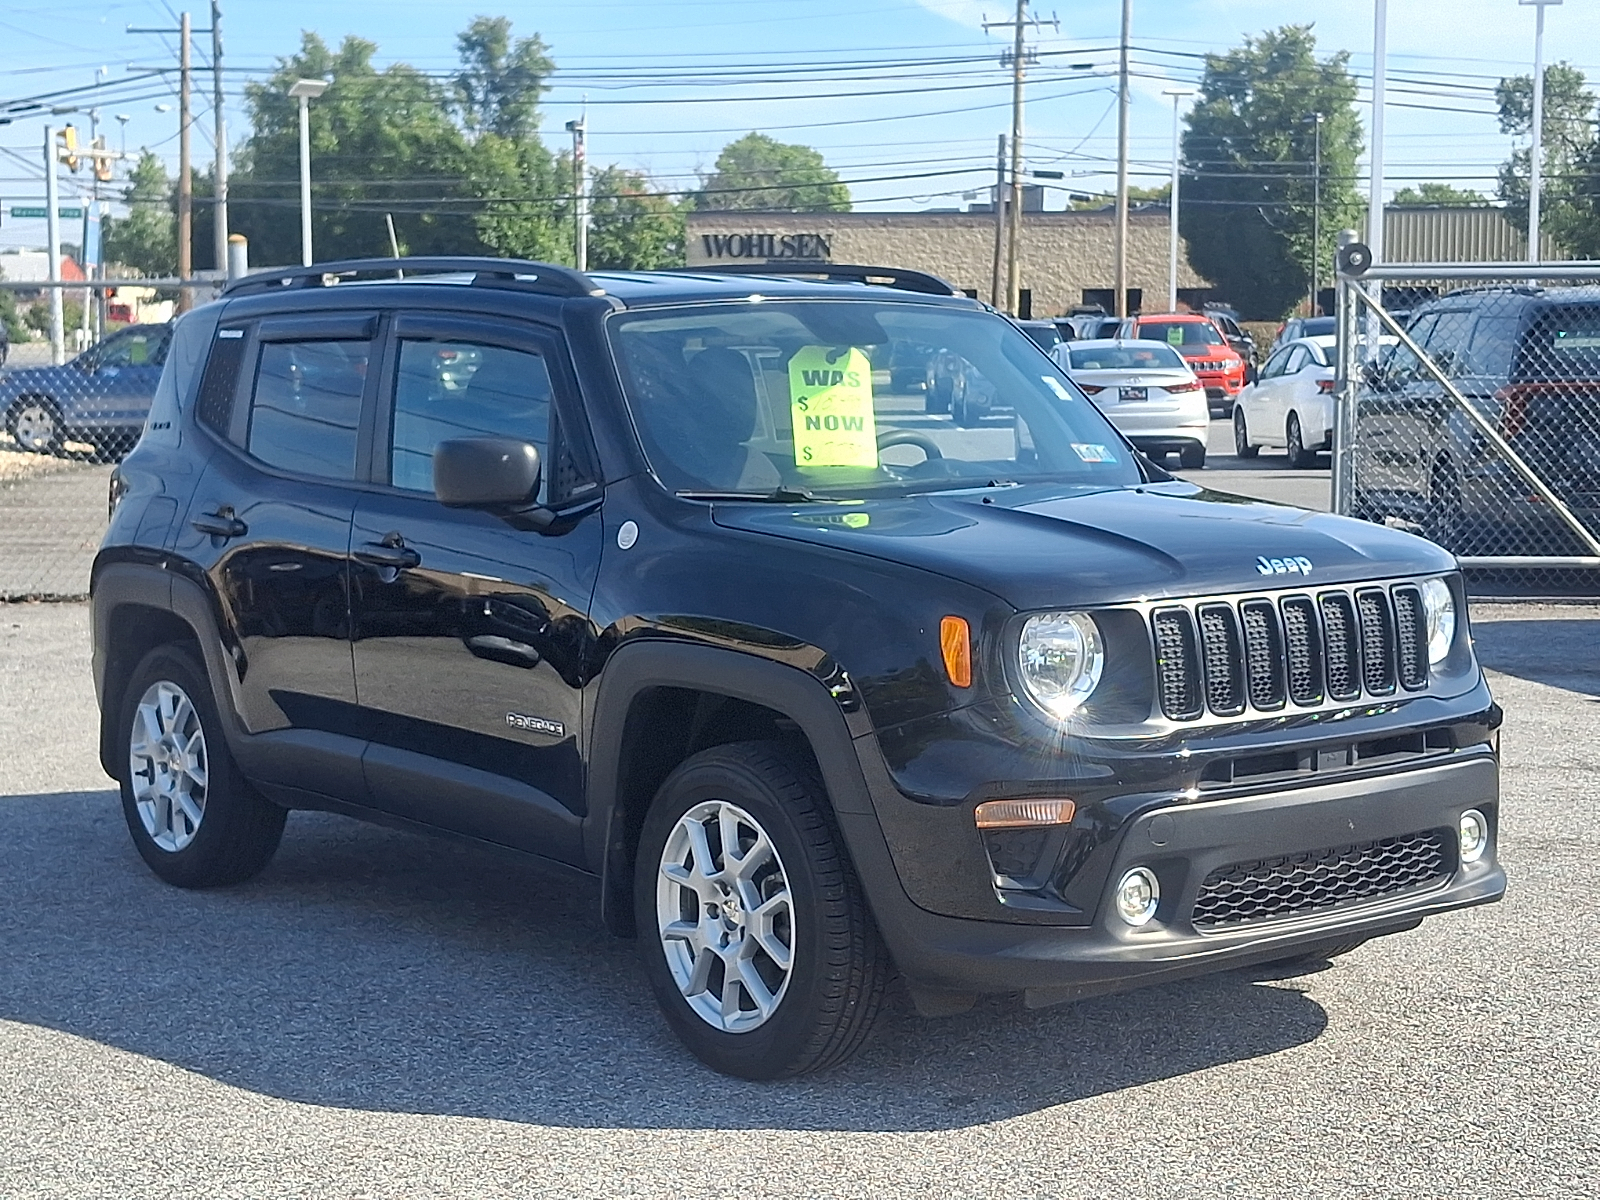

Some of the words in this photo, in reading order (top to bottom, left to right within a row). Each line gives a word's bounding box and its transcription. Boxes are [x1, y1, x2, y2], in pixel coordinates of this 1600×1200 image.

[701, 233, 832, 258] WOHLSEN
[801, 370, 861, 388] WAS
[805, 415, 864, 432] NOW
[1255, 555, 1313, 576] Jeep
[505, 711, 565, 737] RENEGADE
